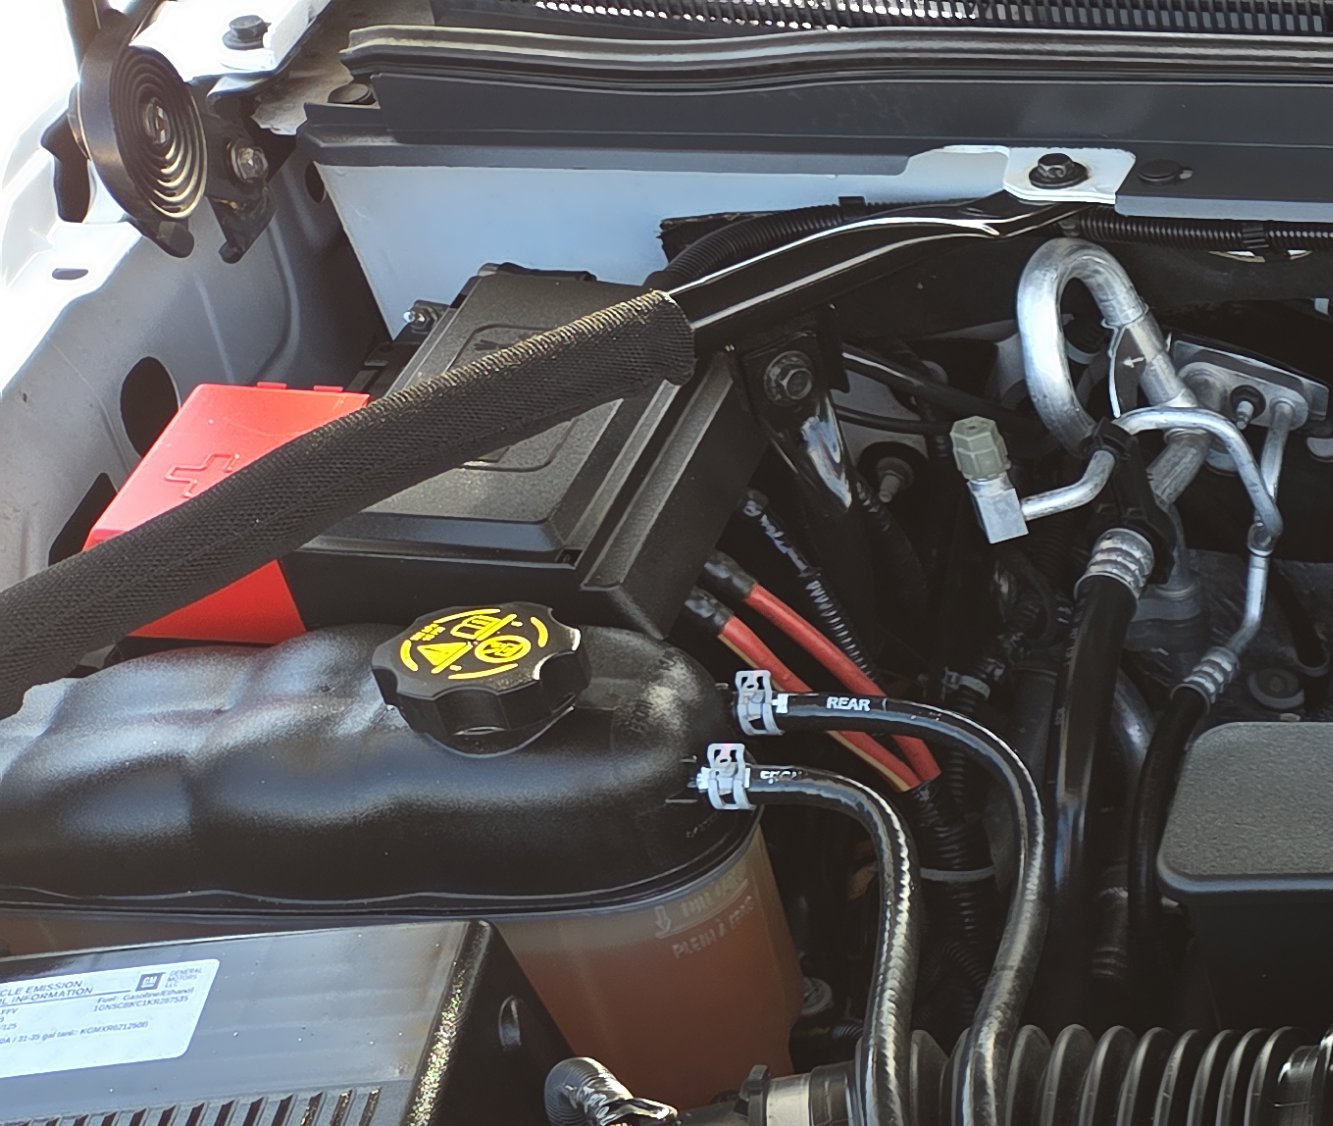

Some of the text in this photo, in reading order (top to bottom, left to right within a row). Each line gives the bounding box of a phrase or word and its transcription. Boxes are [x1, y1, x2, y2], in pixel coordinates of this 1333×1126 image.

[826, 695, 870, 711] REAR
[12, 987, 94, 1003] INFORMATION
[25, 980, 84, 994] EMISSION
